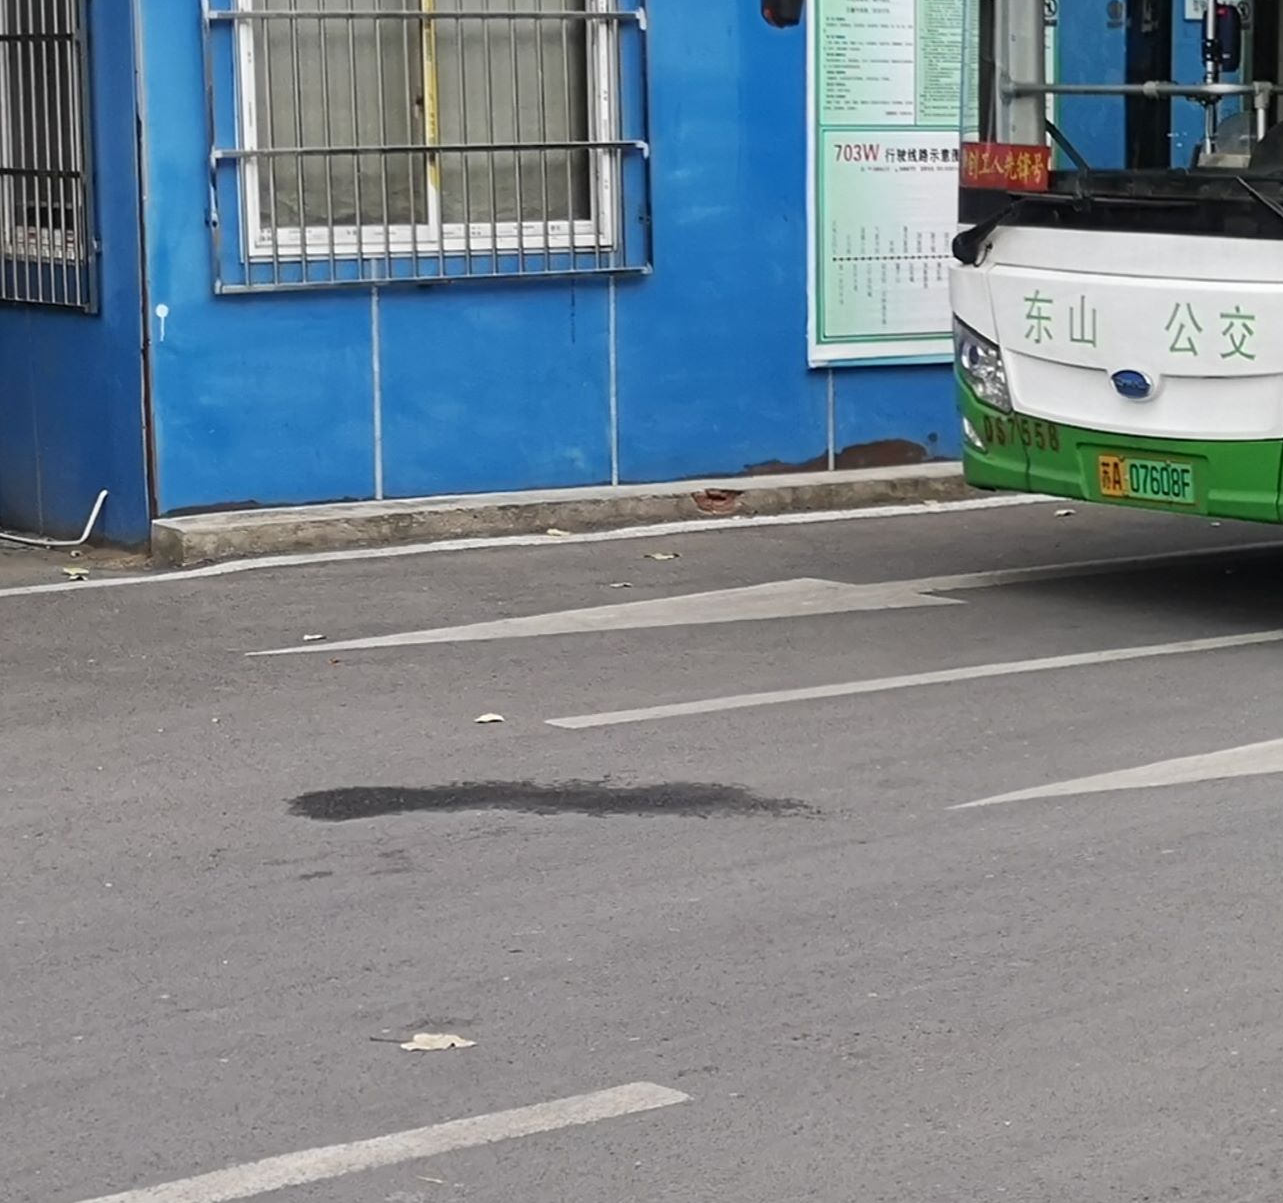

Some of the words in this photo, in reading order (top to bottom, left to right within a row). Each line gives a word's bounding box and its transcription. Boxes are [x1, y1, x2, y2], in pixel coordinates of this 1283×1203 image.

[833, 143, 880, 163] 703W
[1023, 289, 1098, 349] 东山
[1164, 302, 1256, 361] 公交
[983, 414, 1061, 452] DS7558
